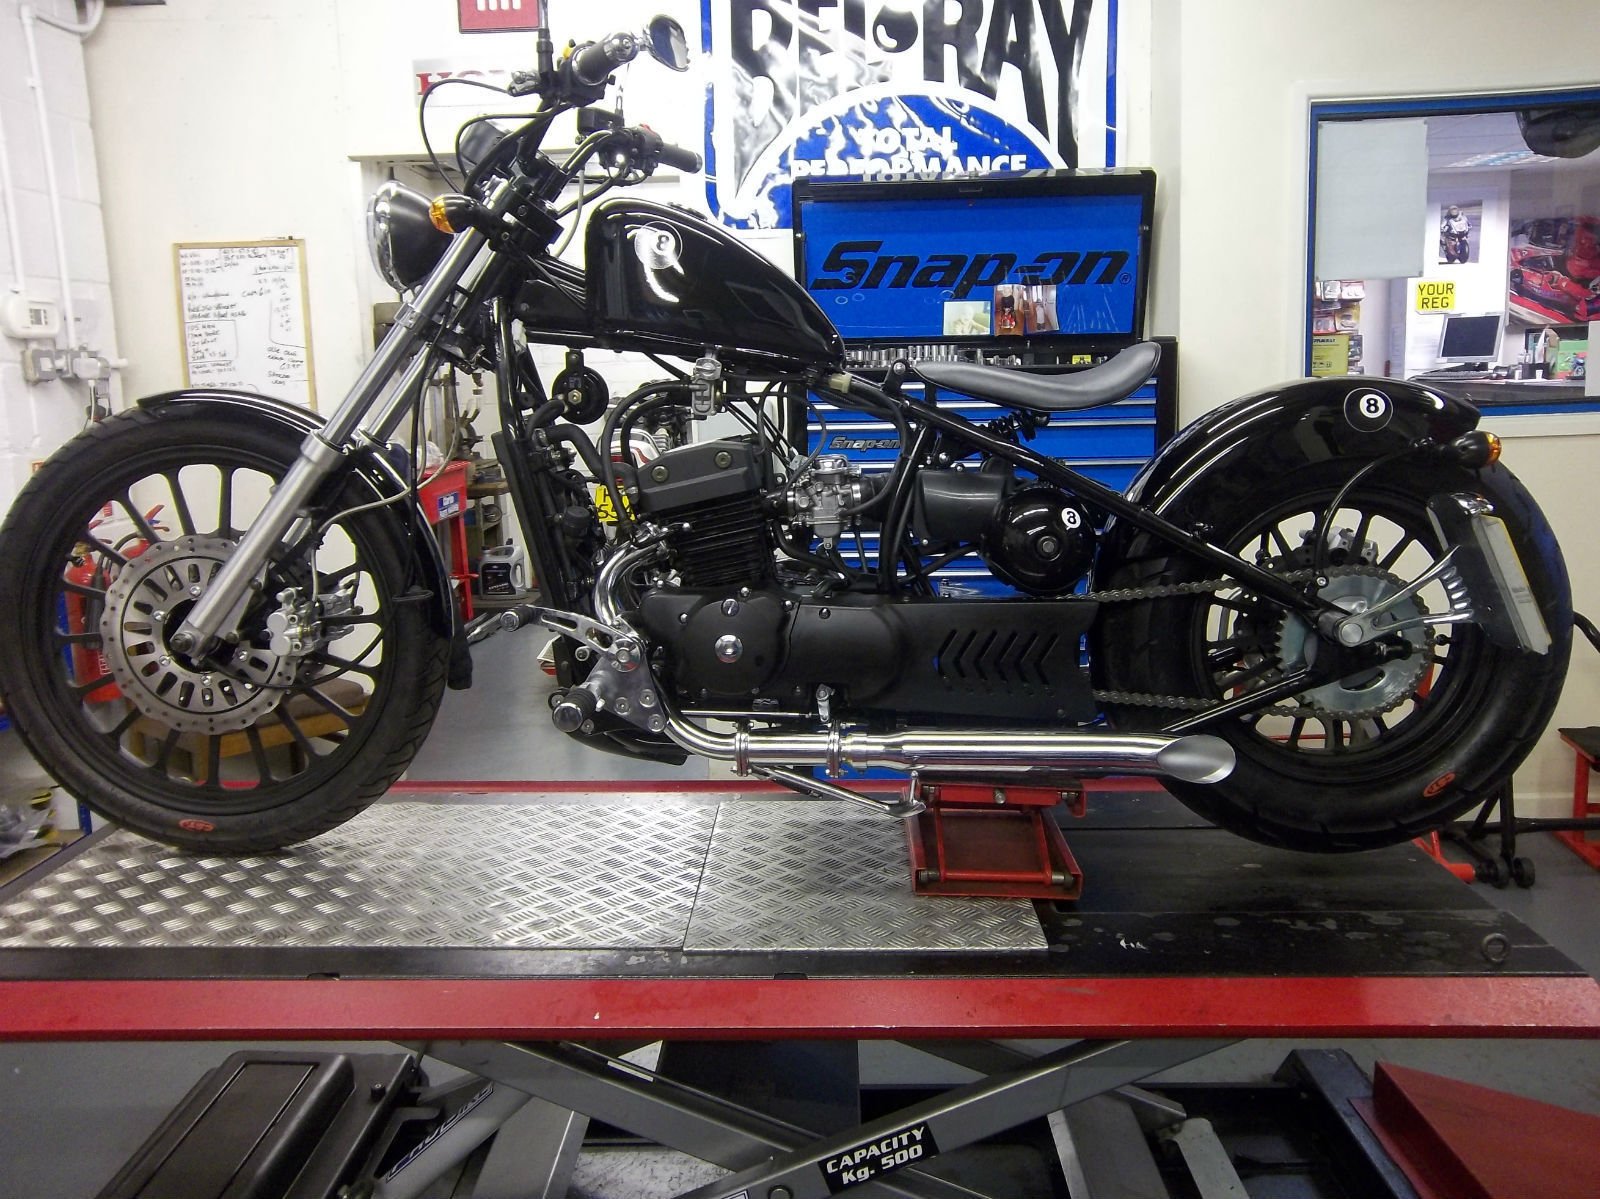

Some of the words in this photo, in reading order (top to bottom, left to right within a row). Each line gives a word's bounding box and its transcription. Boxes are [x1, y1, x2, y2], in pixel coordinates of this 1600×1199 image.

[809, 240, 1131, 300] Snap-on
[1418, 283, 1454, 296] YOUR
[1421, 297, 1449, 309] REG
[1366, 397, 1380, 414] 8
[829, 436, 901, 452] Snap-on
[826, 1126, 925, 1174] CAPACITY
[842, 1165, 876, 1185] Kg.
[881, 1144, 923, 1170] 500
